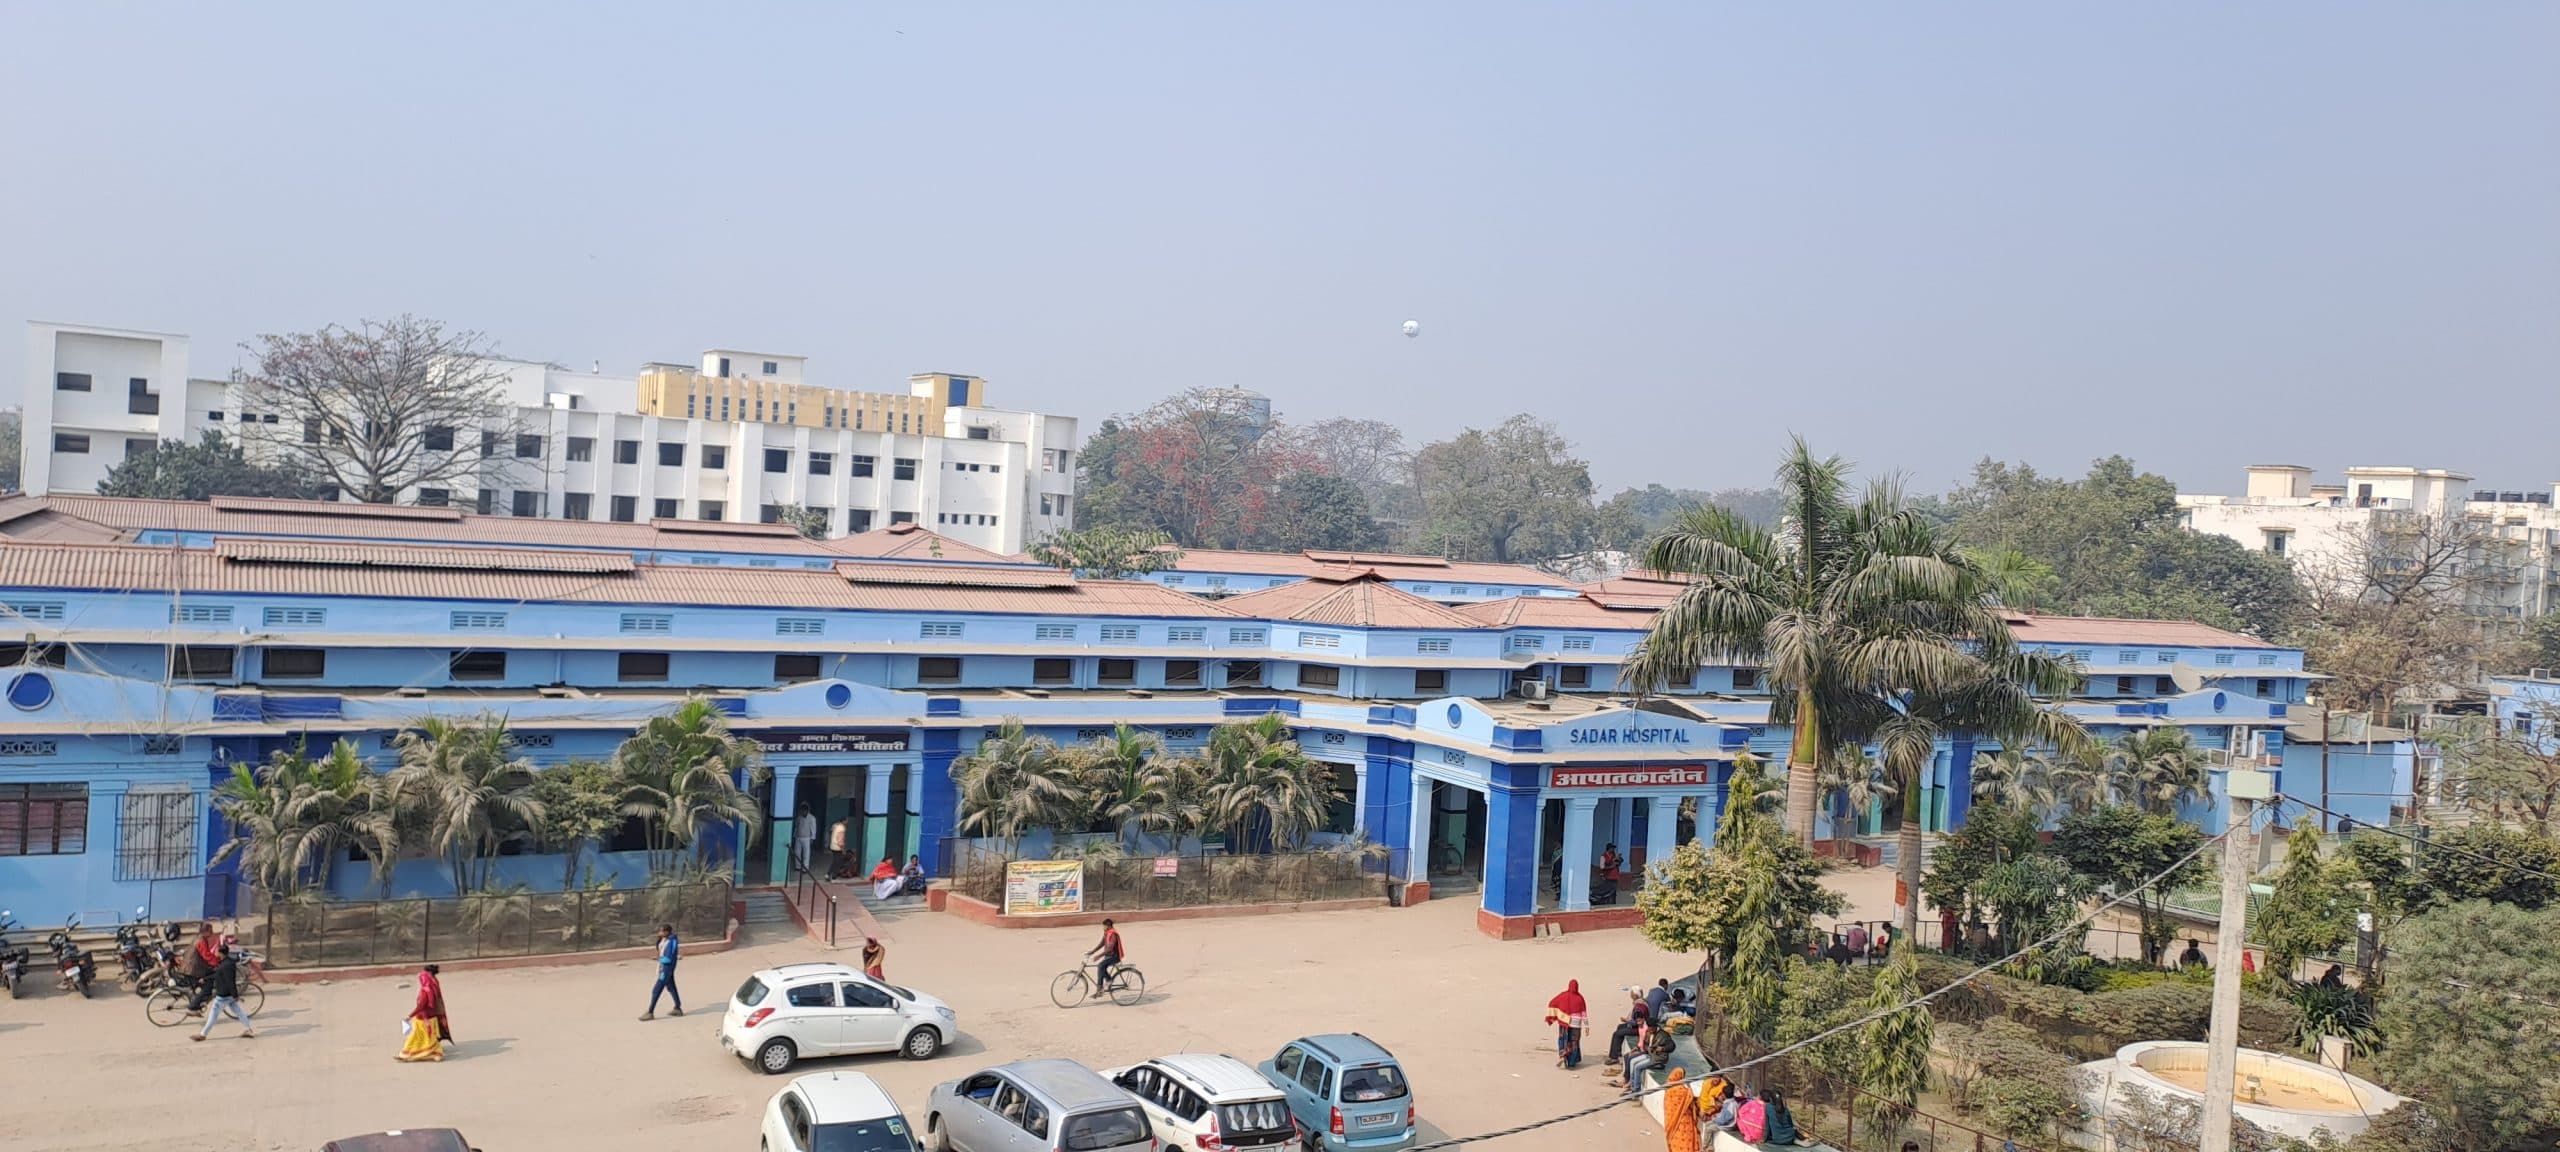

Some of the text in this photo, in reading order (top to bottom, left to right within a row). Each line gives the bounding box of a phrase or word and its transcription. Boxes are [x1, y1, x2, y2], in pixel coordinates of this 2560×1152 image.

[1570, 728, 1690, 743] SADAR HOSPITAL
[1555, 768, 1705, 786] आपातकालीन
